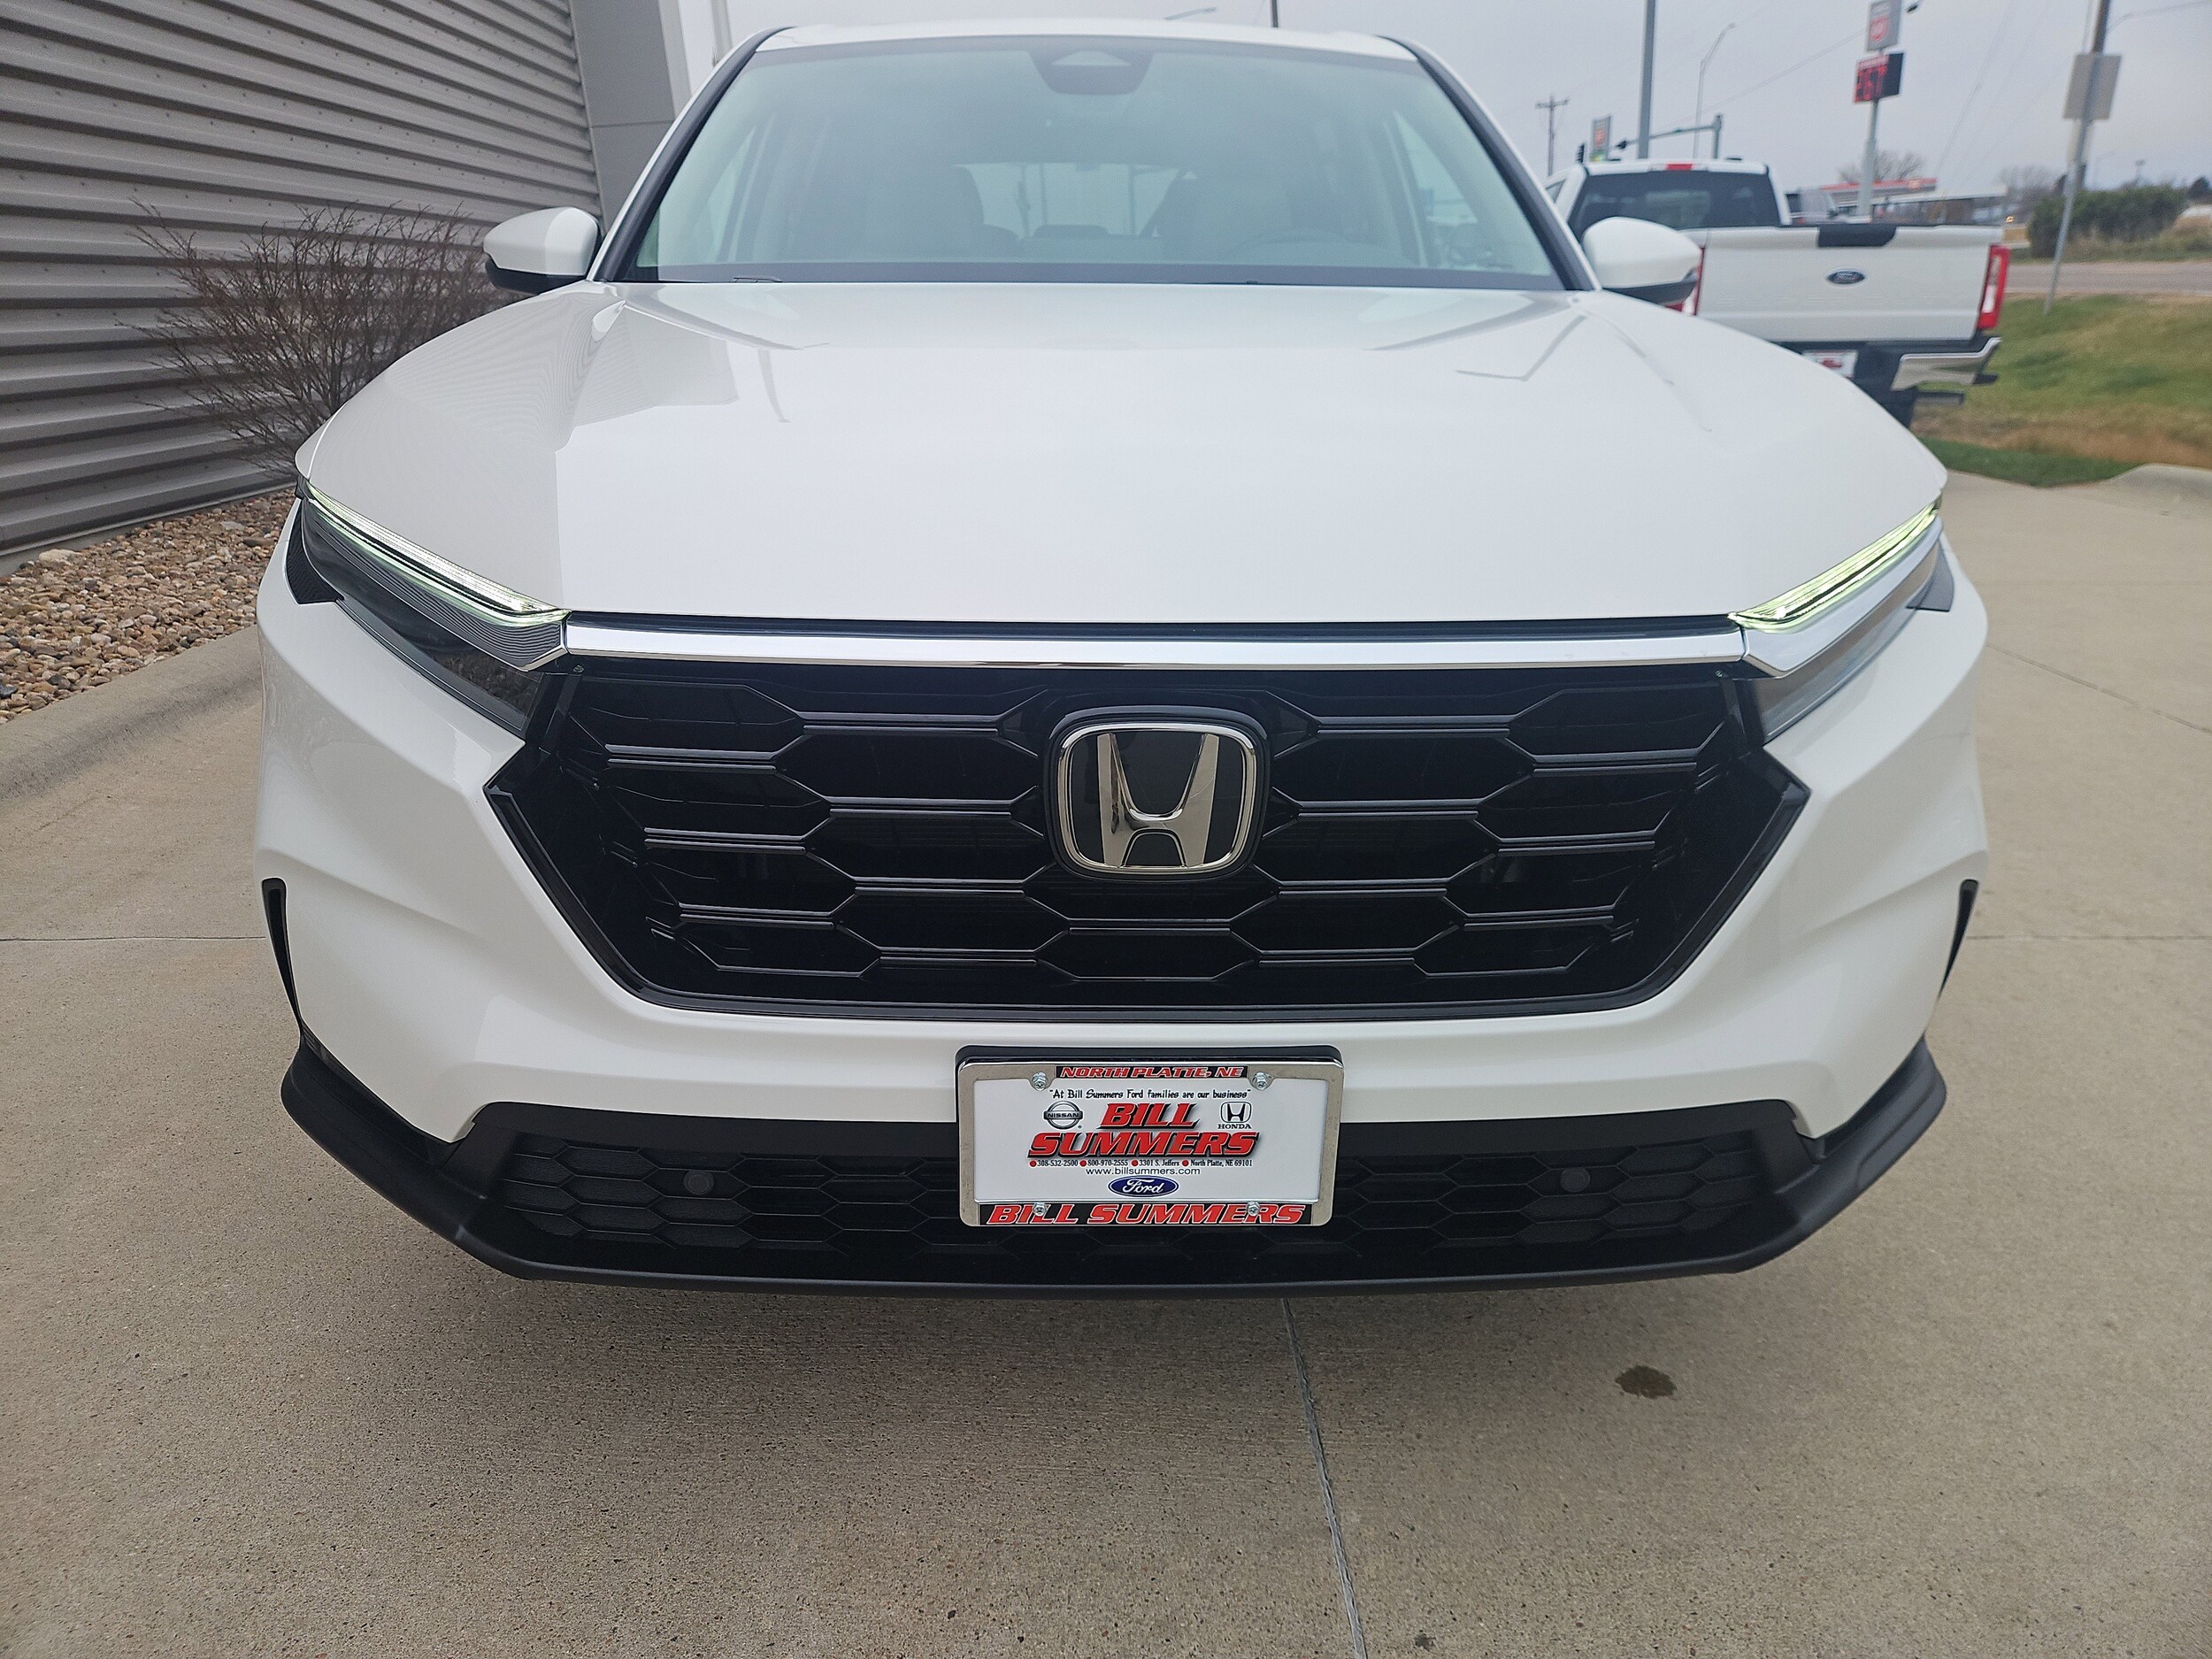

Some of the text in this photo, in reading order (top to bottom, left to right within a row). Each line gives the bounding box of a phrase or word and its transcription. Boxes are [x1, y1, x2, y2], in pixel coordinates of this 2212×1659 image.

[1061, 1066, 1244, 1078] NORTH PLATTE, NE
[1068, 1089, 1083, 1098] Bill
[1086, 1089, 1124, 1099] Summers
[1126, 1089, 1143, 1098] Ford
[1148, 1089, 1179, 1099] families
[1098, 1102, 1200, 1129] BILL
[1028, 1132, 1260, 1157] SUMMERS
[1122, 1178, 1164, 1194] Ford
[987, 1203, 1306, 1225] BILL SUMMERS
